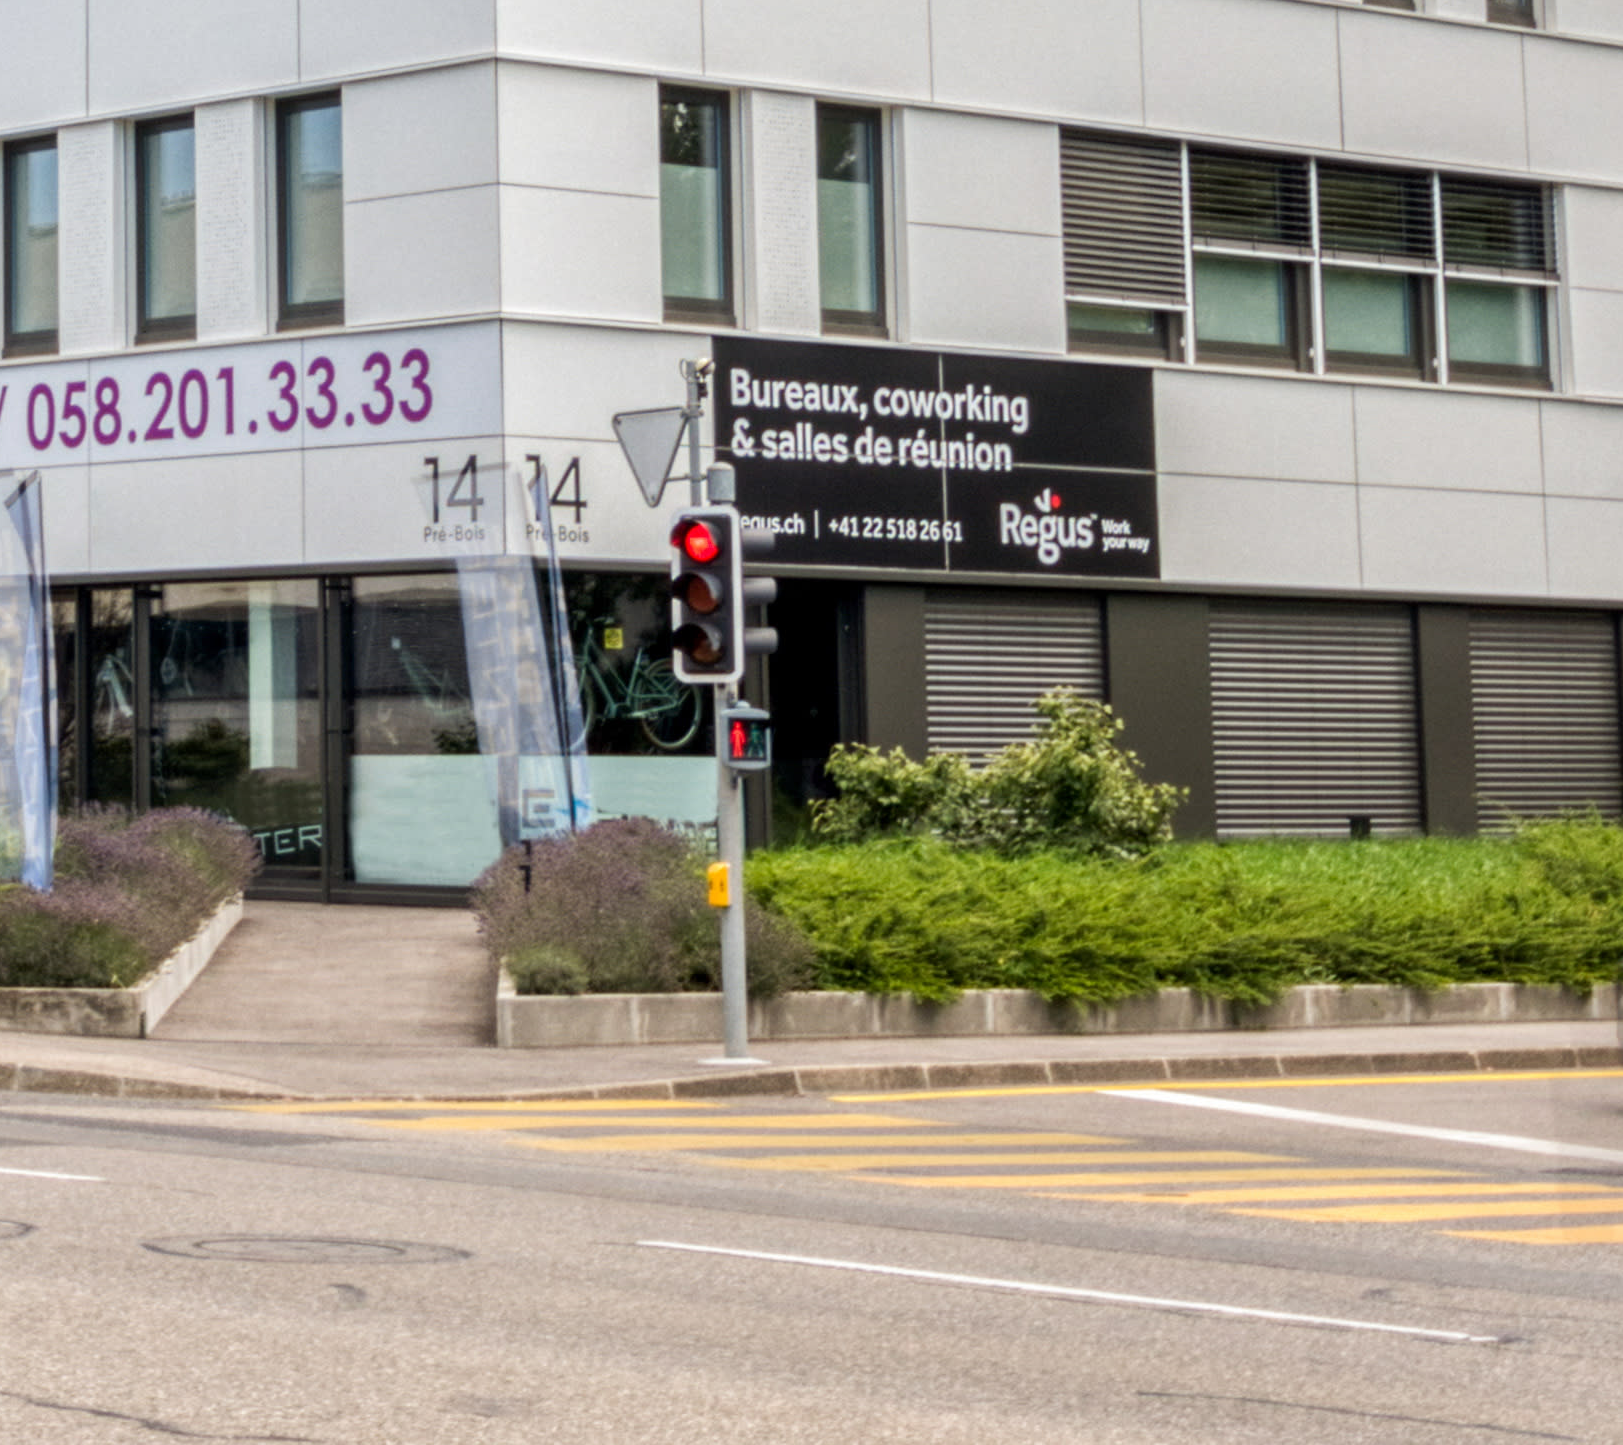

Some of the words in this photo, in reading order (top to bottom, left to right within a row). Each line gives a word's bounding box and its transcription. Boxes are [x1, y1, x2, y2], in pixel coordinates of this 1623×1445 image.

[26, 348, 434, 450] 058.201.33.33
[730, 367, 868, 421] Bureaux,
[873, 384, 1028, 434] coworking
[731, 417, 755, 457] &
[761, 422, 849, 463] salles
[854, 425, 893, 466] de
[898, 428, 1013, 472] réunion
[424, 454, 484, 524] 14
[423, 523, 485, 542] Pré-Bois
[740, 512, 805, 534] egus.ch
[828, 516, 859, 537] +41
[862, 517, 883, 538] 22
[886, 518, 917, 539] 518
[919, 519, 940, 541] 26
[942, 521, 963, 542] 61
[1102, 518, 1131, 534] Work
[1102, 536, 1127, 552] your
[1128, 536, 1150, 553] way
